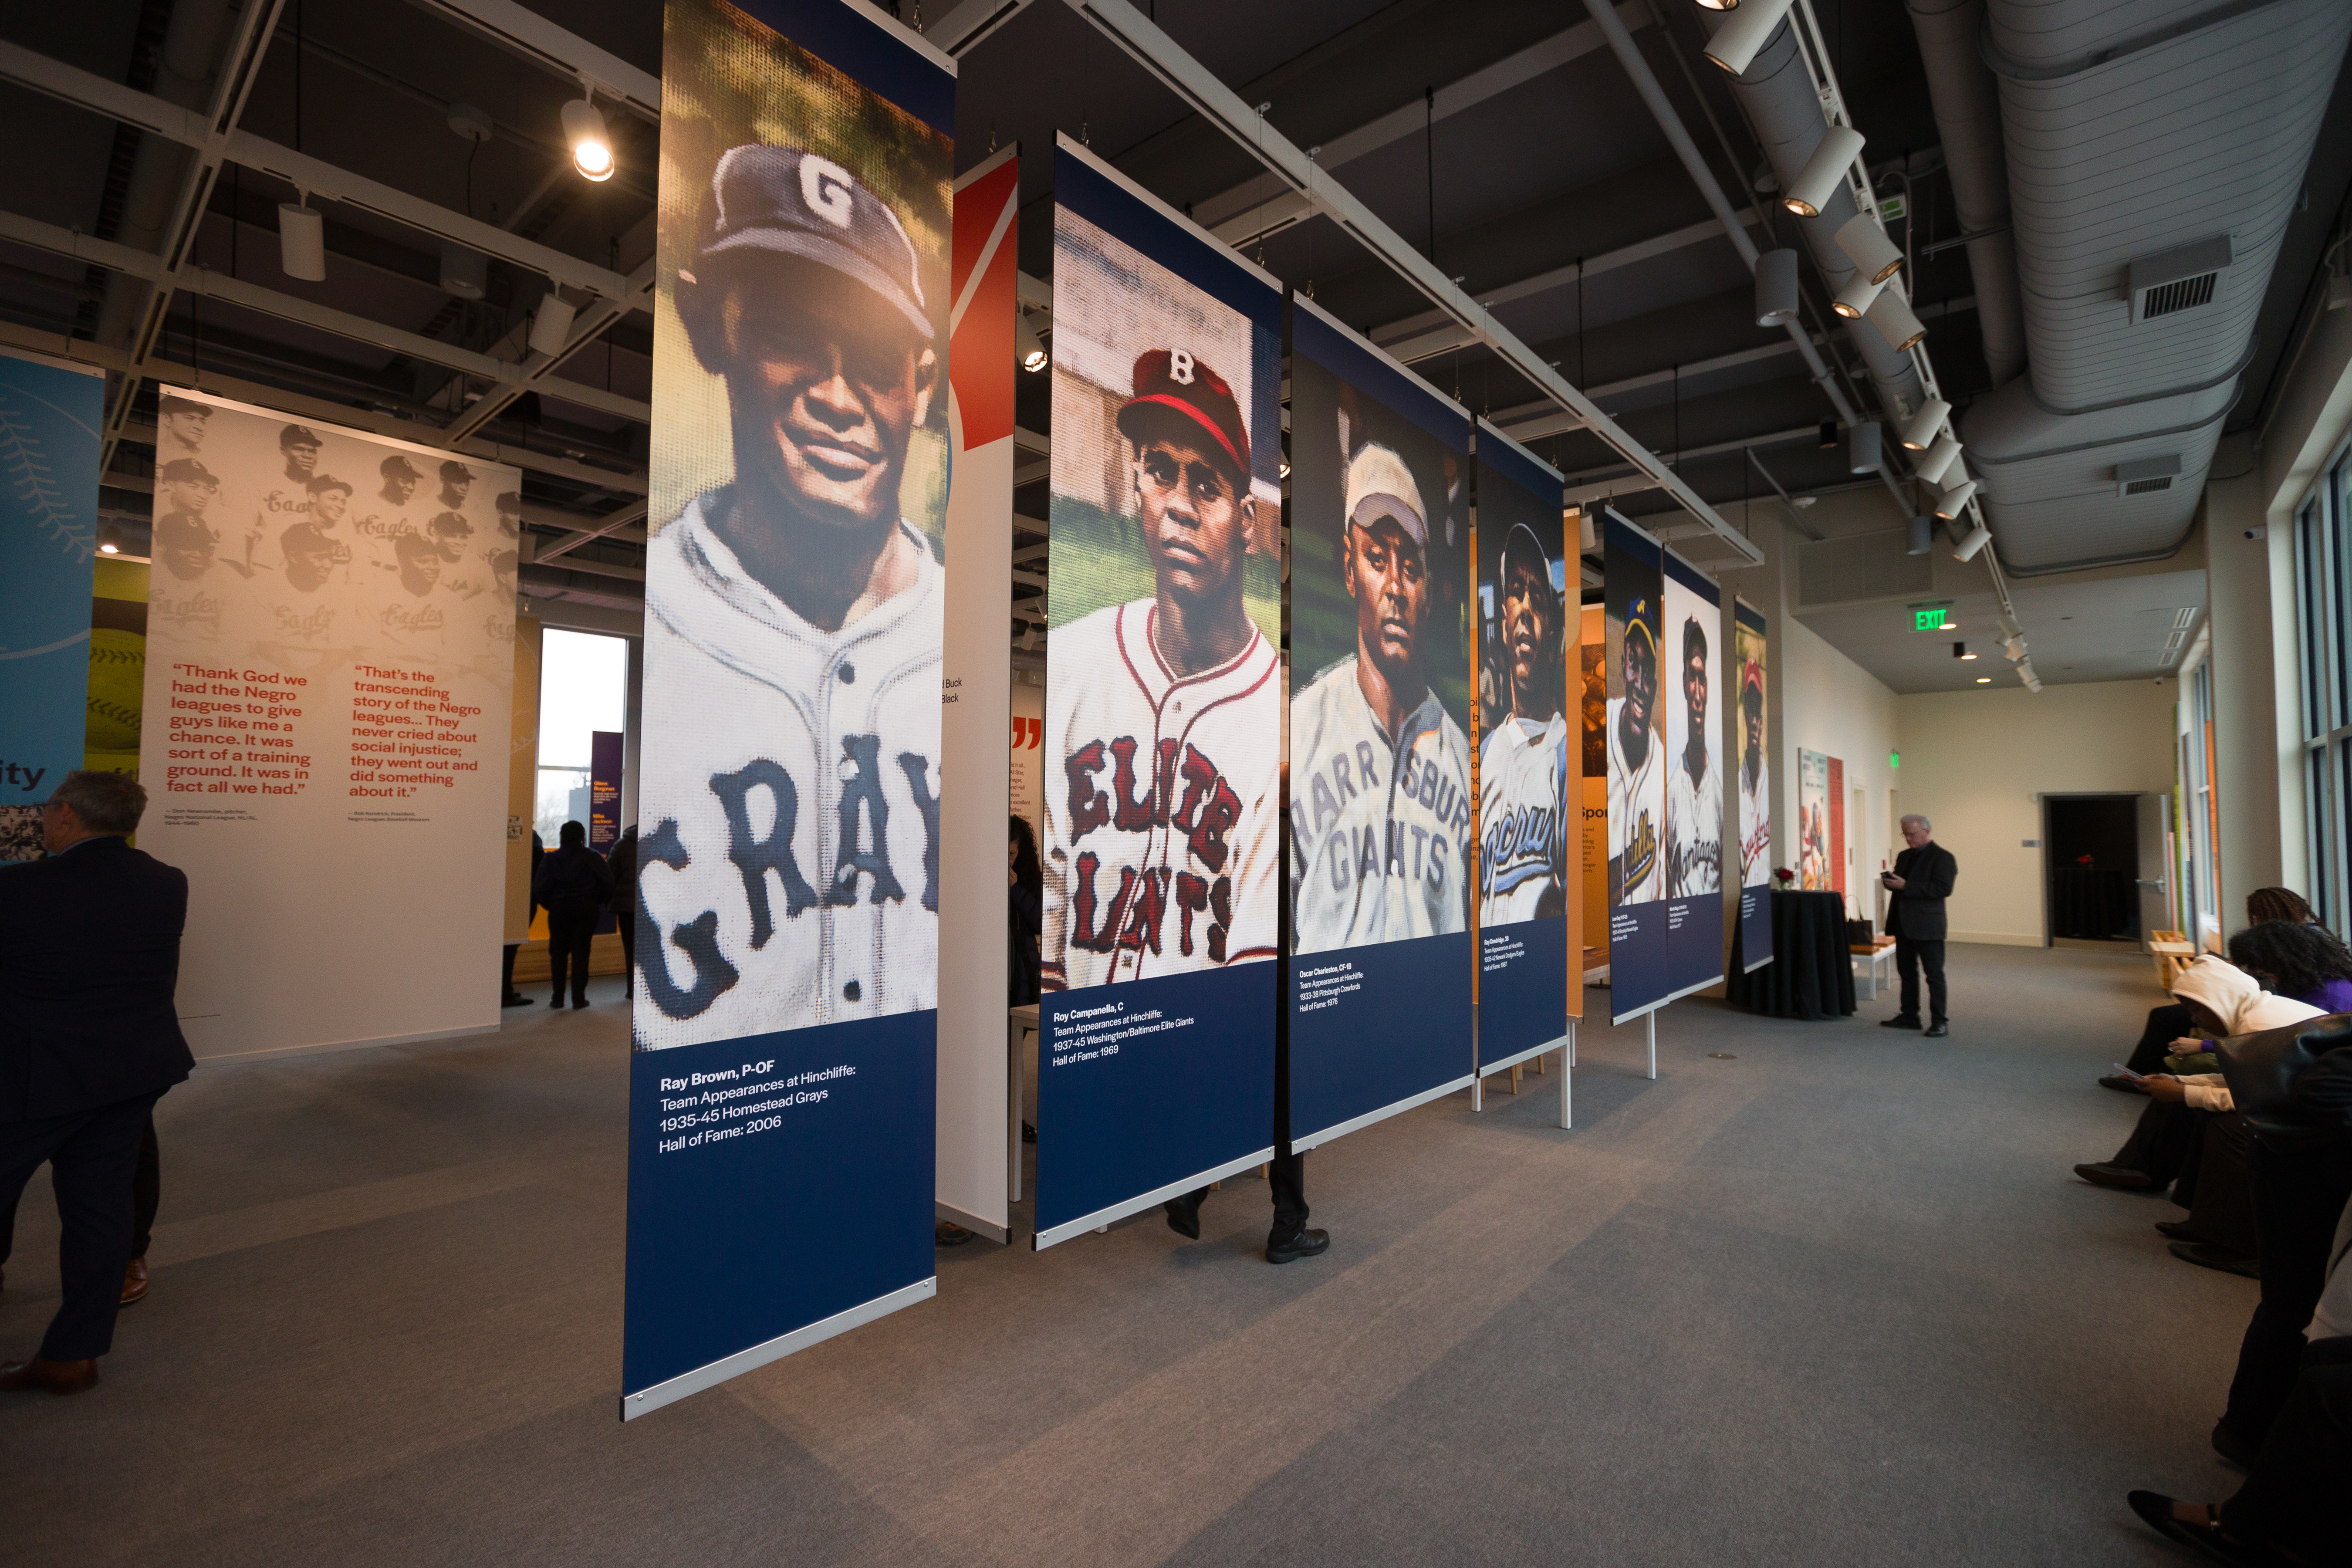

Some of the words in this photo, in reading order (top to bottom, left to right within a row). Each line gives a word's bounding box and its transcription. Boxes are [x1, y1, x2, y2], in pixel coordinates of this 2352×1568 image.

[799, 153, 853, 229] G
[1169, 348, 1195, 385] B
[1916, 609, 1948, 630] EXIT
[173, 663, 238, 680] “Thank
[243, 670, 279, 684] God
[284, 676, 307, 686] we
[355, 665, 408, 680] “That’s
[412, 671, 435, 683] the
[946, 677, 962, 688] Buck
[172, 680, 206, 694] had
[211, 683, 240, 696] the
[245, 686, 296, 703] Negro
[354, 681, 449, 701] transcending
[942, 693, 959, 703] Black
[171, 696, 242, 714] leagues
[247, 703, 263, 714] to
[267, 704, 302, 719] give
[353, 697, 392, 711] story
[395, 699, 410, 710] of
[413, 700, 436, 711] the
[439, 702, 481, 717] Negro
[169, 716, 213, 729] guys
[218, 716, 248, 729] like
[253, 721, 279, 731] me
[283, 723, 293, 732] a
[353, 710, 422, 726] leagues...
[426, 715, 460, 730] They
[169, 730, 240, 745] chance.
[245, 734, 256, 746] It
[260, 737, 293, 747] was
[352, 727, 393, 738] never
[397, 729, 434, 740] cried
[437, 731, 477, 743] about
[169, 749, 205, 759] sort
[210, 749, 228, 760] of
[232, 752, 242, 761] a
[247, 751, 311, 767] training
[351, 742, 395, 753] social
[399, 743, 462, 758] injustice;
[167, 765, 237, 779] ground.
[242, 766, 253, 777] It
[257, 769, 290, 779] was
[294, 768, 308, 779] in
[351, 755, 384, 770] they
[387, 759, 422, 769] went
[426, 760, 449, 770] out
[452, 761, 478, 771] and
[167, 780, 203, 792] fact
[207, 781, 228, 793] all
[232, 784, 257, 793] we
[262, 783, 305, 794] had.”
[350, 770, 374, 781] did
[378, 773, 453, 787] something
[349, 786, 393, 797] about
[397, 787, 417, 797] it.”
[1312, 977, 1339, 988] Appearances
[1344, 972, 1363, 981] Hinchliffe:
[1314, 966, 1338, 975] Charleston,
[1299, 990, 1318, 1000] 1933-38
[1319, 987, 1340, 997] Pittsburgh
[1340, 983, 1360, 992] Crawfords
[1054, 1012, 1069, 1023] Roy
[1070, 1004, 1117, 1019] Campanella,
[1118, 1002, 1124, 1011] C
[1299, 1004, 1308, 1012] Hall
[1054, 1027, 1074, 1037] Team
[1075, 1018, 1122, 1034] Appearances
[1122, 1015, 1129, 1024] at
[1130, 1009, 1162, 1023] Hinchliffe:
[1053, 1037, 1085, 1051] 1937-45
[1087, 1024, 1160, 1045] Washington/Baltimore
[1161, 1021, 1174, 1030] Elite
[1175, 1017, 1194, 1027] Giants
[1053, 1055, 1068, 1067] Hall
[1068, 1053, 1077, 1063] of
[1078, 1051, 1099, 1061] Fame:
[1100, 1044, 1119, 1056] 1969
[661, 1078, 689, 1092] Ray
[692, 1069, 739, 1086] Brown,
[742, 1060, 775, 1077] P-OF
[660, 1096, 697, 1112] Team
[700, 1080, 784, 1105] Appearances
[787, 1075, 798, 1087] at
[801, 1064, 856, 1085] Hinchliffe:
[660, 1108, 720, 1132] 1935-45
[723, 1094, 793, 1119] Homestead
[796, 1090, 828, 1104] Grays
[659, 1135, 686, 1153] Hall
[689, 1132, 703, 1146] of
[705, 1127, 743, 1143] Fame:
[746, 1115, 781, 1134] 2006
